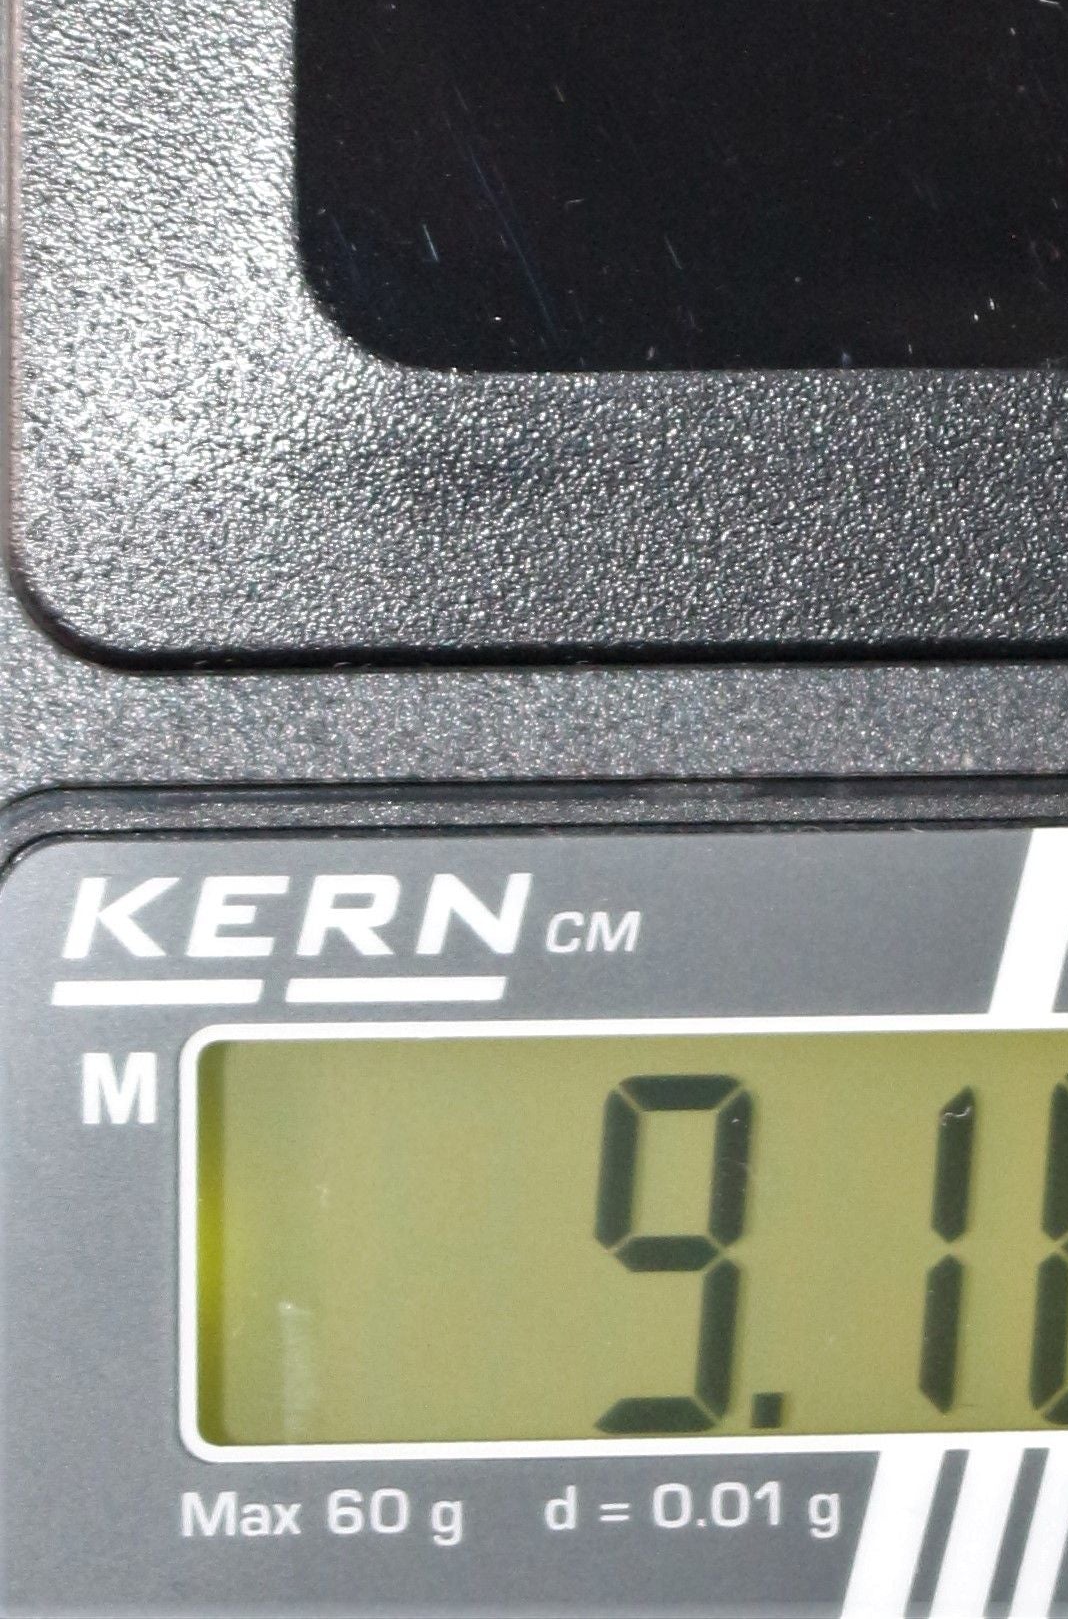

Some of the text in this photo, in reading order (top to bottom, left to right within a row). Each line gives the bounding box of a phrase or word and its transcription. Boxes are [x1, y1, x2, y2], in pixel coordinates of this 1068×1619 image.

[62, 873, 641, 959] KERN CM
[82, 1052, 156, 1125] M
[181, 1488, 463, 1545] Max 60 g
[546, 1481, 842, 1538] d = 0.01 g
